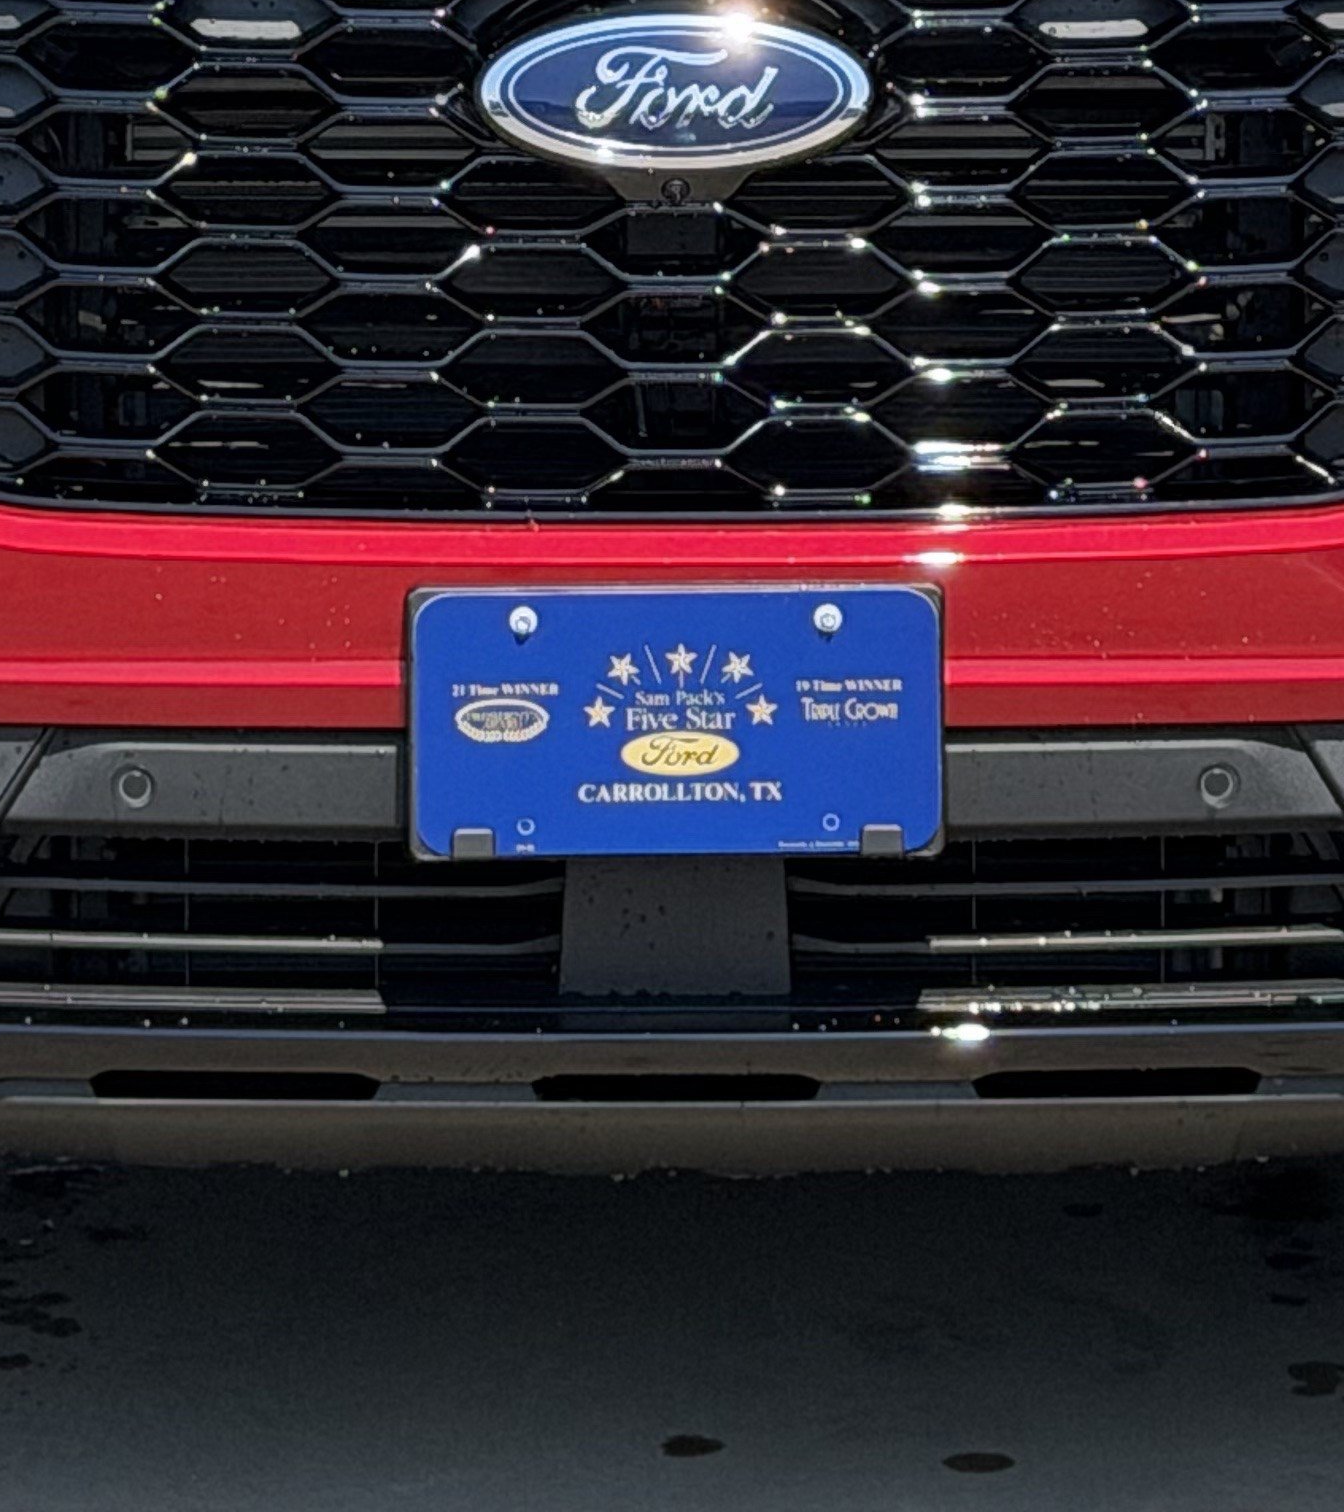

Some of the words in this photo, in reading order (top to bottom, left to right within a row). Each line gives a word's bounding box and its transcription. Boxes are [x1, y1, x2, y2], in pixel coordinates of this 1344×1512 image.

[575, 45, 780, 130] Ford
[634, 690, 670, 706] Sam
[675, 689, 726, 706] Pack's
[625, 707, 679, 731] Five
[686, 705, 736, 730] Star
[641, 735, 719, 767] Ford
[577, 782, 746, 803] CARROLLTON,
[749, 780, 783, 802] TX
